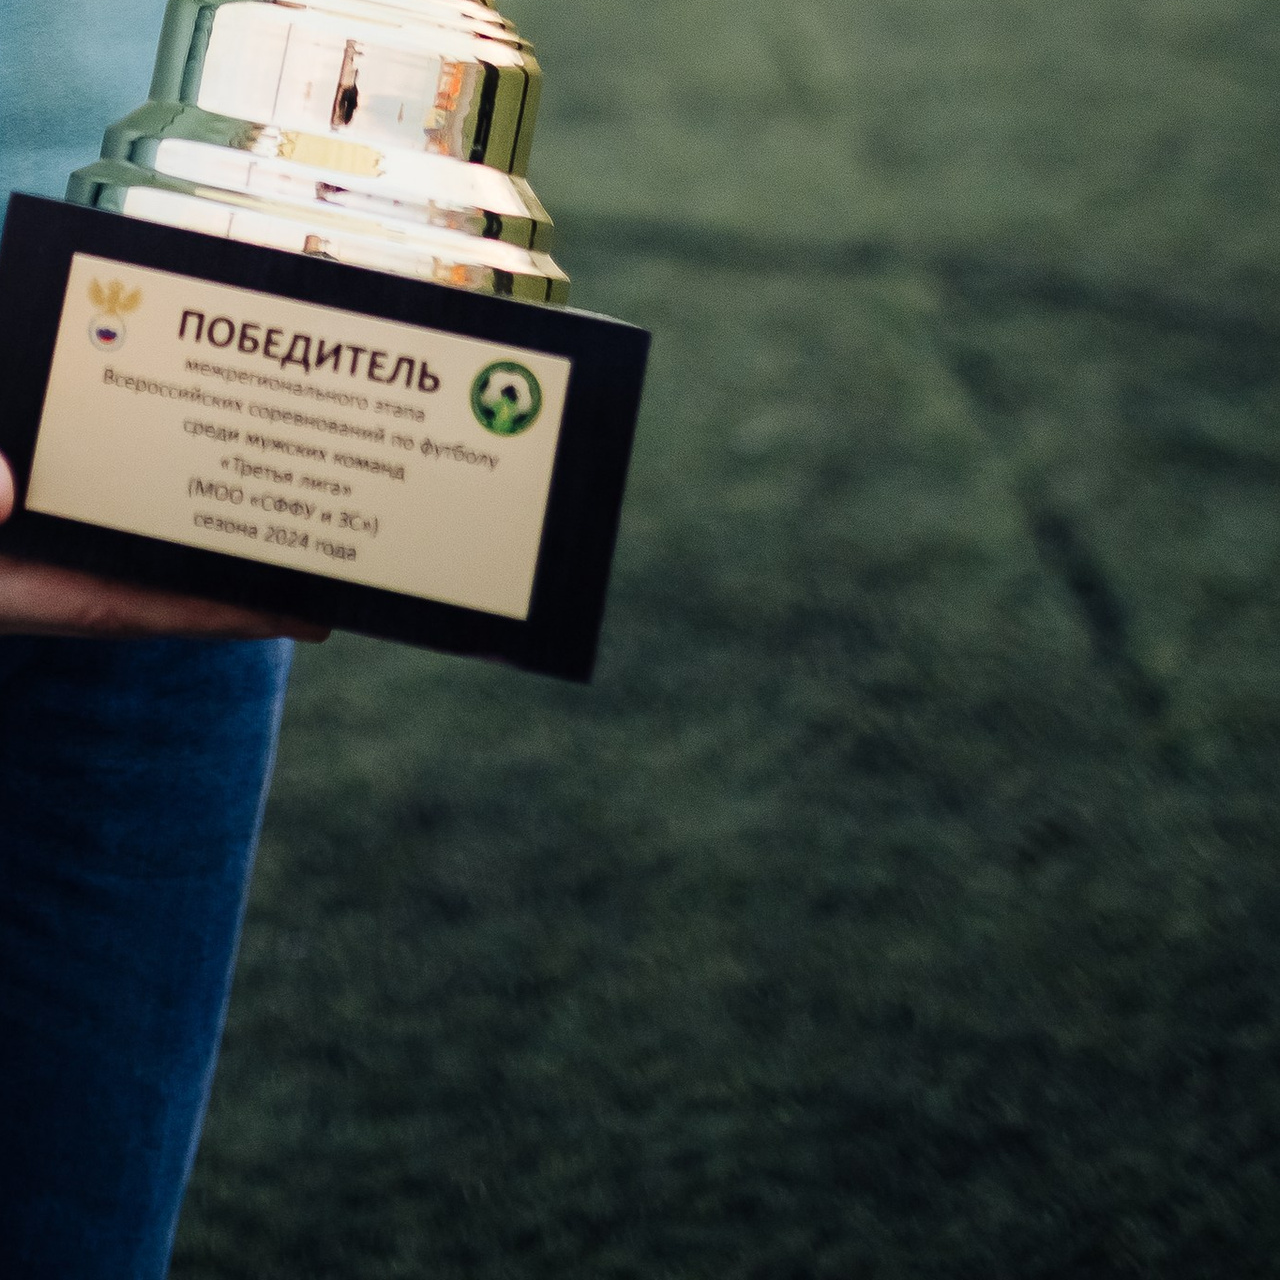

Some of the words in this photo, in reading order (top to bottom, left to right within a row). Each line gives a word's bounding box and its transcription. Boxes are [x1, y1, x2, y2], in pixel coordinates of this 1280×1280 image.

[177, 308, 441, 394] ПОБЕДИТЕЛЬ
[102, 365, 243, 412] Всероссийских
[248, 402, 385, 444] соревнований
[391, 433, 415, 451] по
[420, 438, 500, 473] футболу
[184, 357, 369, 410] межрегионального
[374, 398, 426, 423] этапа
[183, 420, 240, 443] среди
[245, 431, 327, 462] мужских
[333, 452, 406, 482] команд
[221, 456, 294, 484] «Третья
[299, 476, 352, 497] лига»
[187, 476, 244, 505] (МОО
[320, 510, 333, 525] и
[193, 512, 259, 540] сезона
[264, 523, 310, 550] 2024
[314, 539, 358, 562] года
